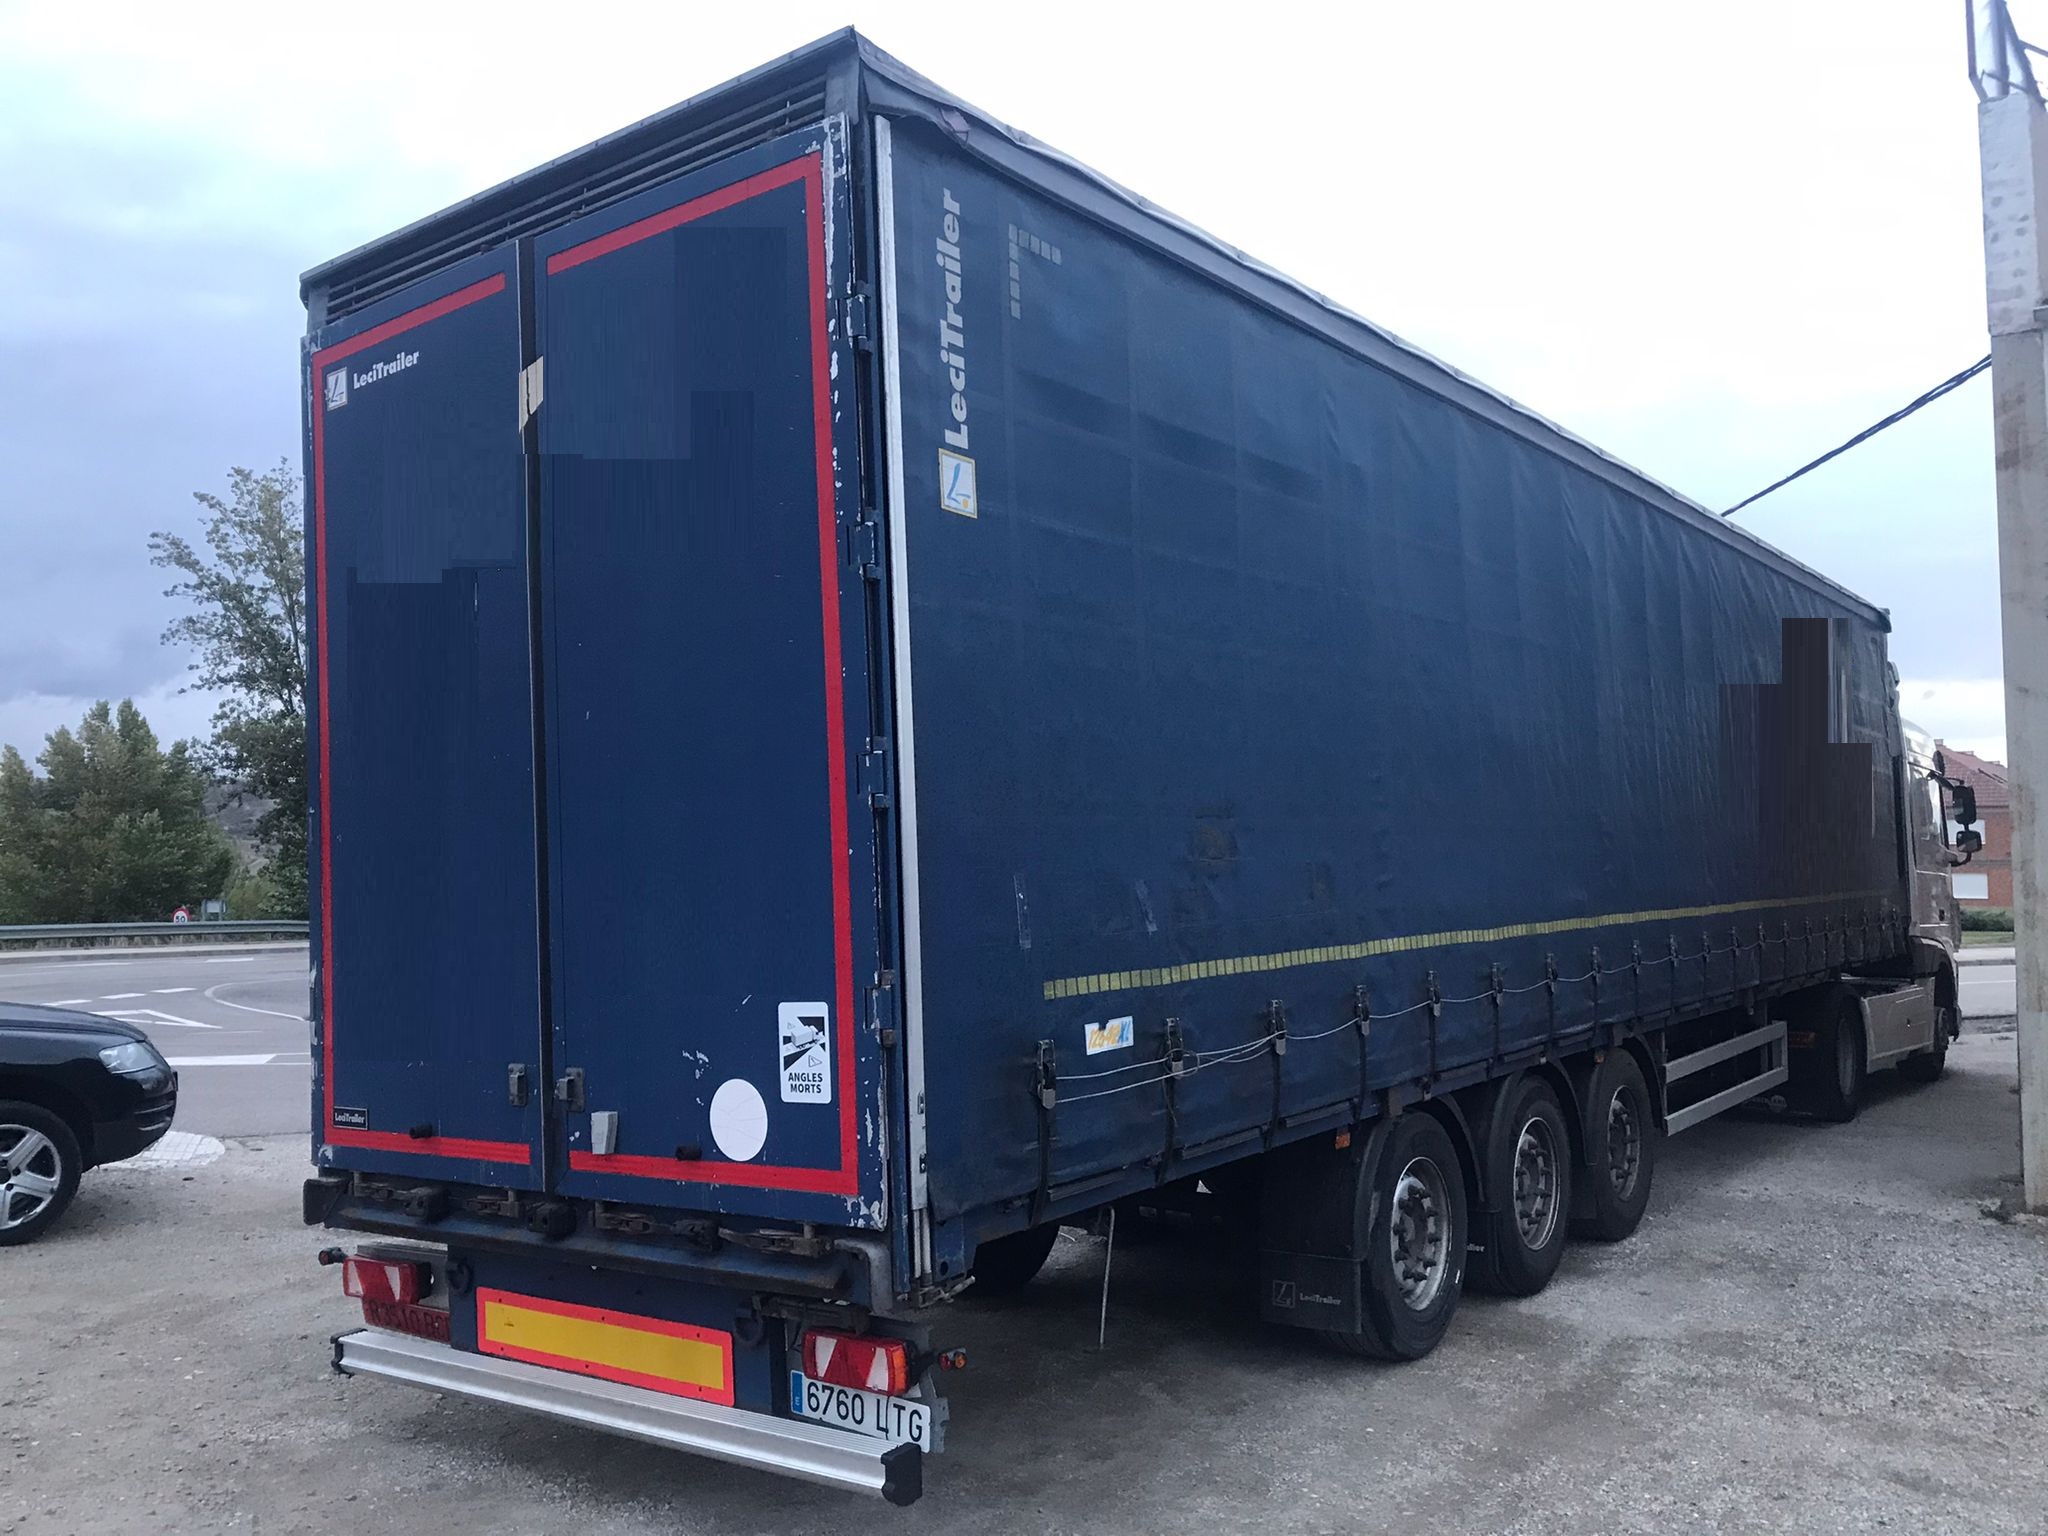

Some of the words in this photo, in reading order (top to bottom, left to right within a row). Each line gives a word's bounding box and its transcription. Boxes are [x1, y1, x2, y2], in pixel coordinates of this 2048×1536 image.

[936, 188, 969, 450] LeciTrailer
[353, 351, 420, 390] LeciTrailer
[788, 1072, 823, 1083] ANGLES
[790, 1083, 822, 1094] MORTS
[807, 1381, 864, 1425] 6760
[876, 1398, 923, 1443] LTG
